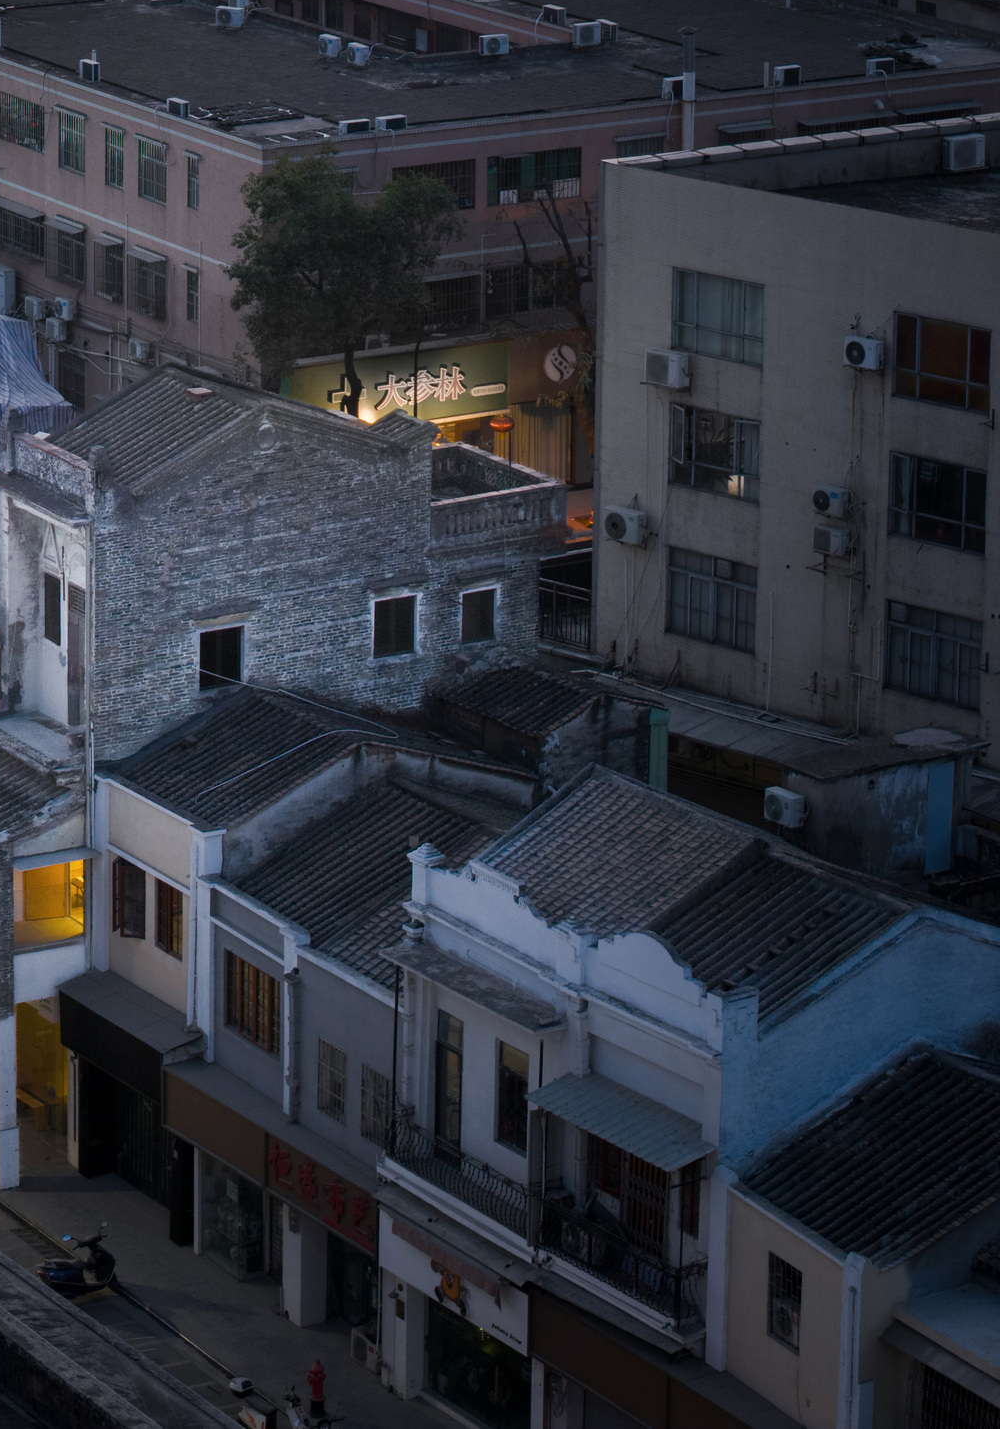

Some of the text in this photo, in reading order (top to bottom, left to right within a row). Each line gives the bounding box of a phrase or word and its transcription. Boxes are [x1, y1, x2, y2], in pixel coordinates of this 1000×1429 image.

[376, 363, 466, 411] 大参林
[267, 1142, 374, 1241] 恒盛布艺
